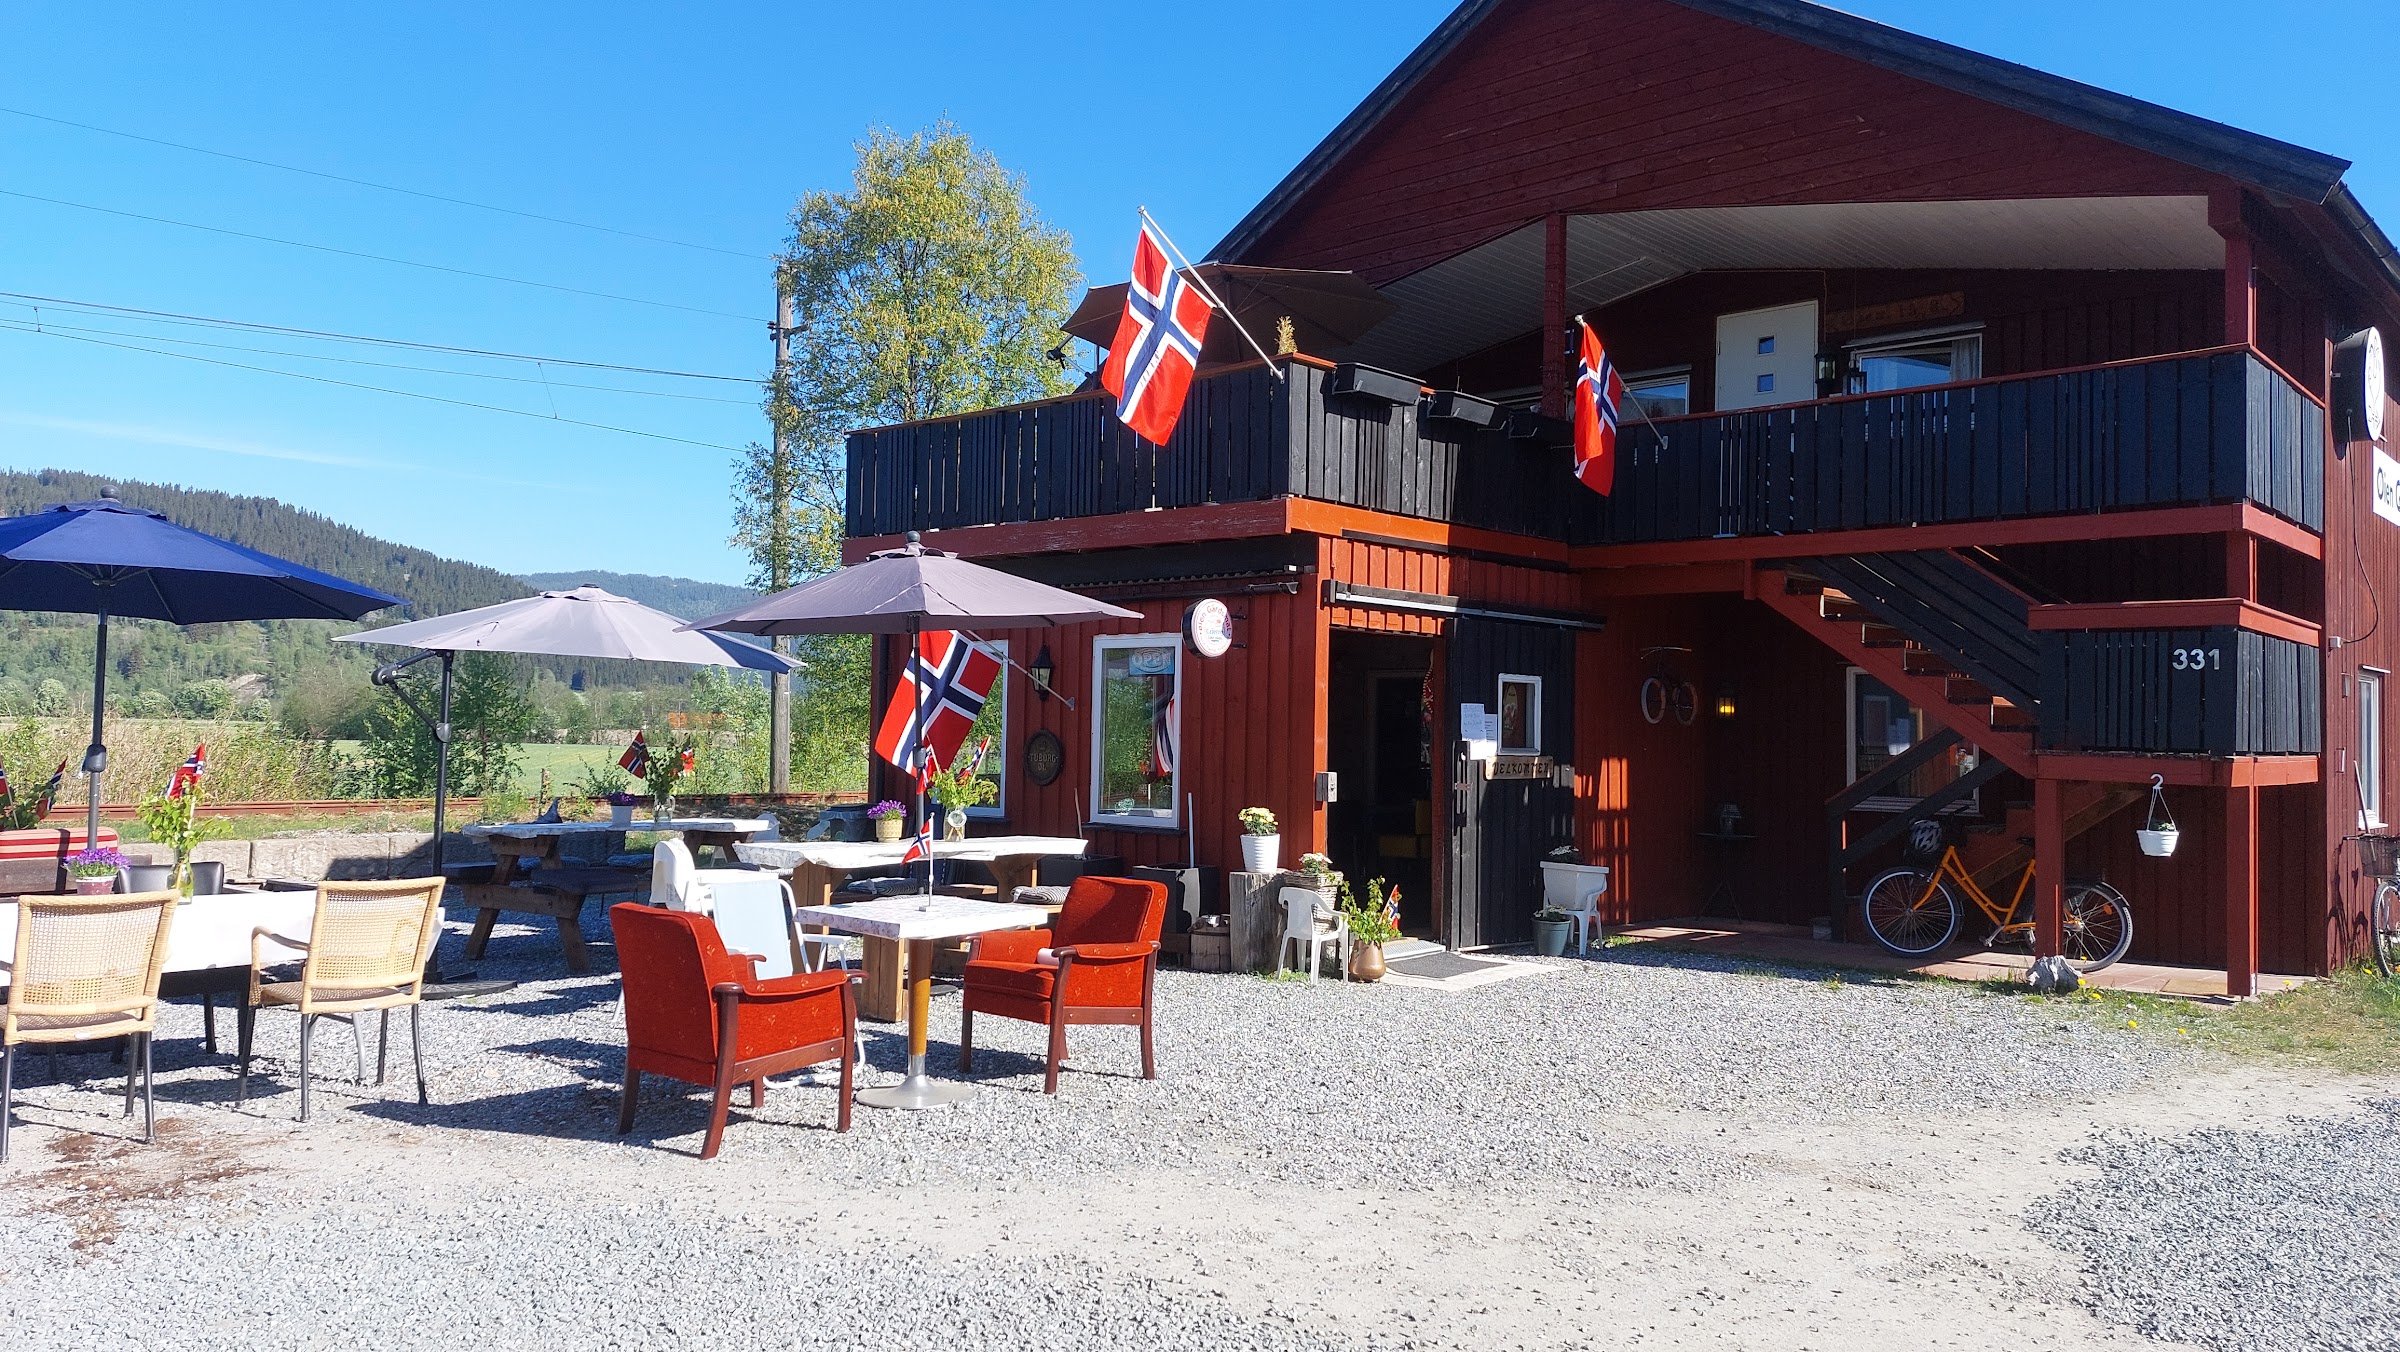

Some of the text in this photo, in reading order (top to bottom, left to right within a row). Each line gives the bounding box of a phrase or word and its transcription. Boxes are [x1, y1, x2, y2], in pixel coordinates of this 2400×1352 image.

[1131, 652, 1171, 665] OPEN
[2172, 648, 2220, 670] 331
[1029, 752, 1056, 763] TUBORG
[1492, 761, 1550, 775] VELKOMMEN
